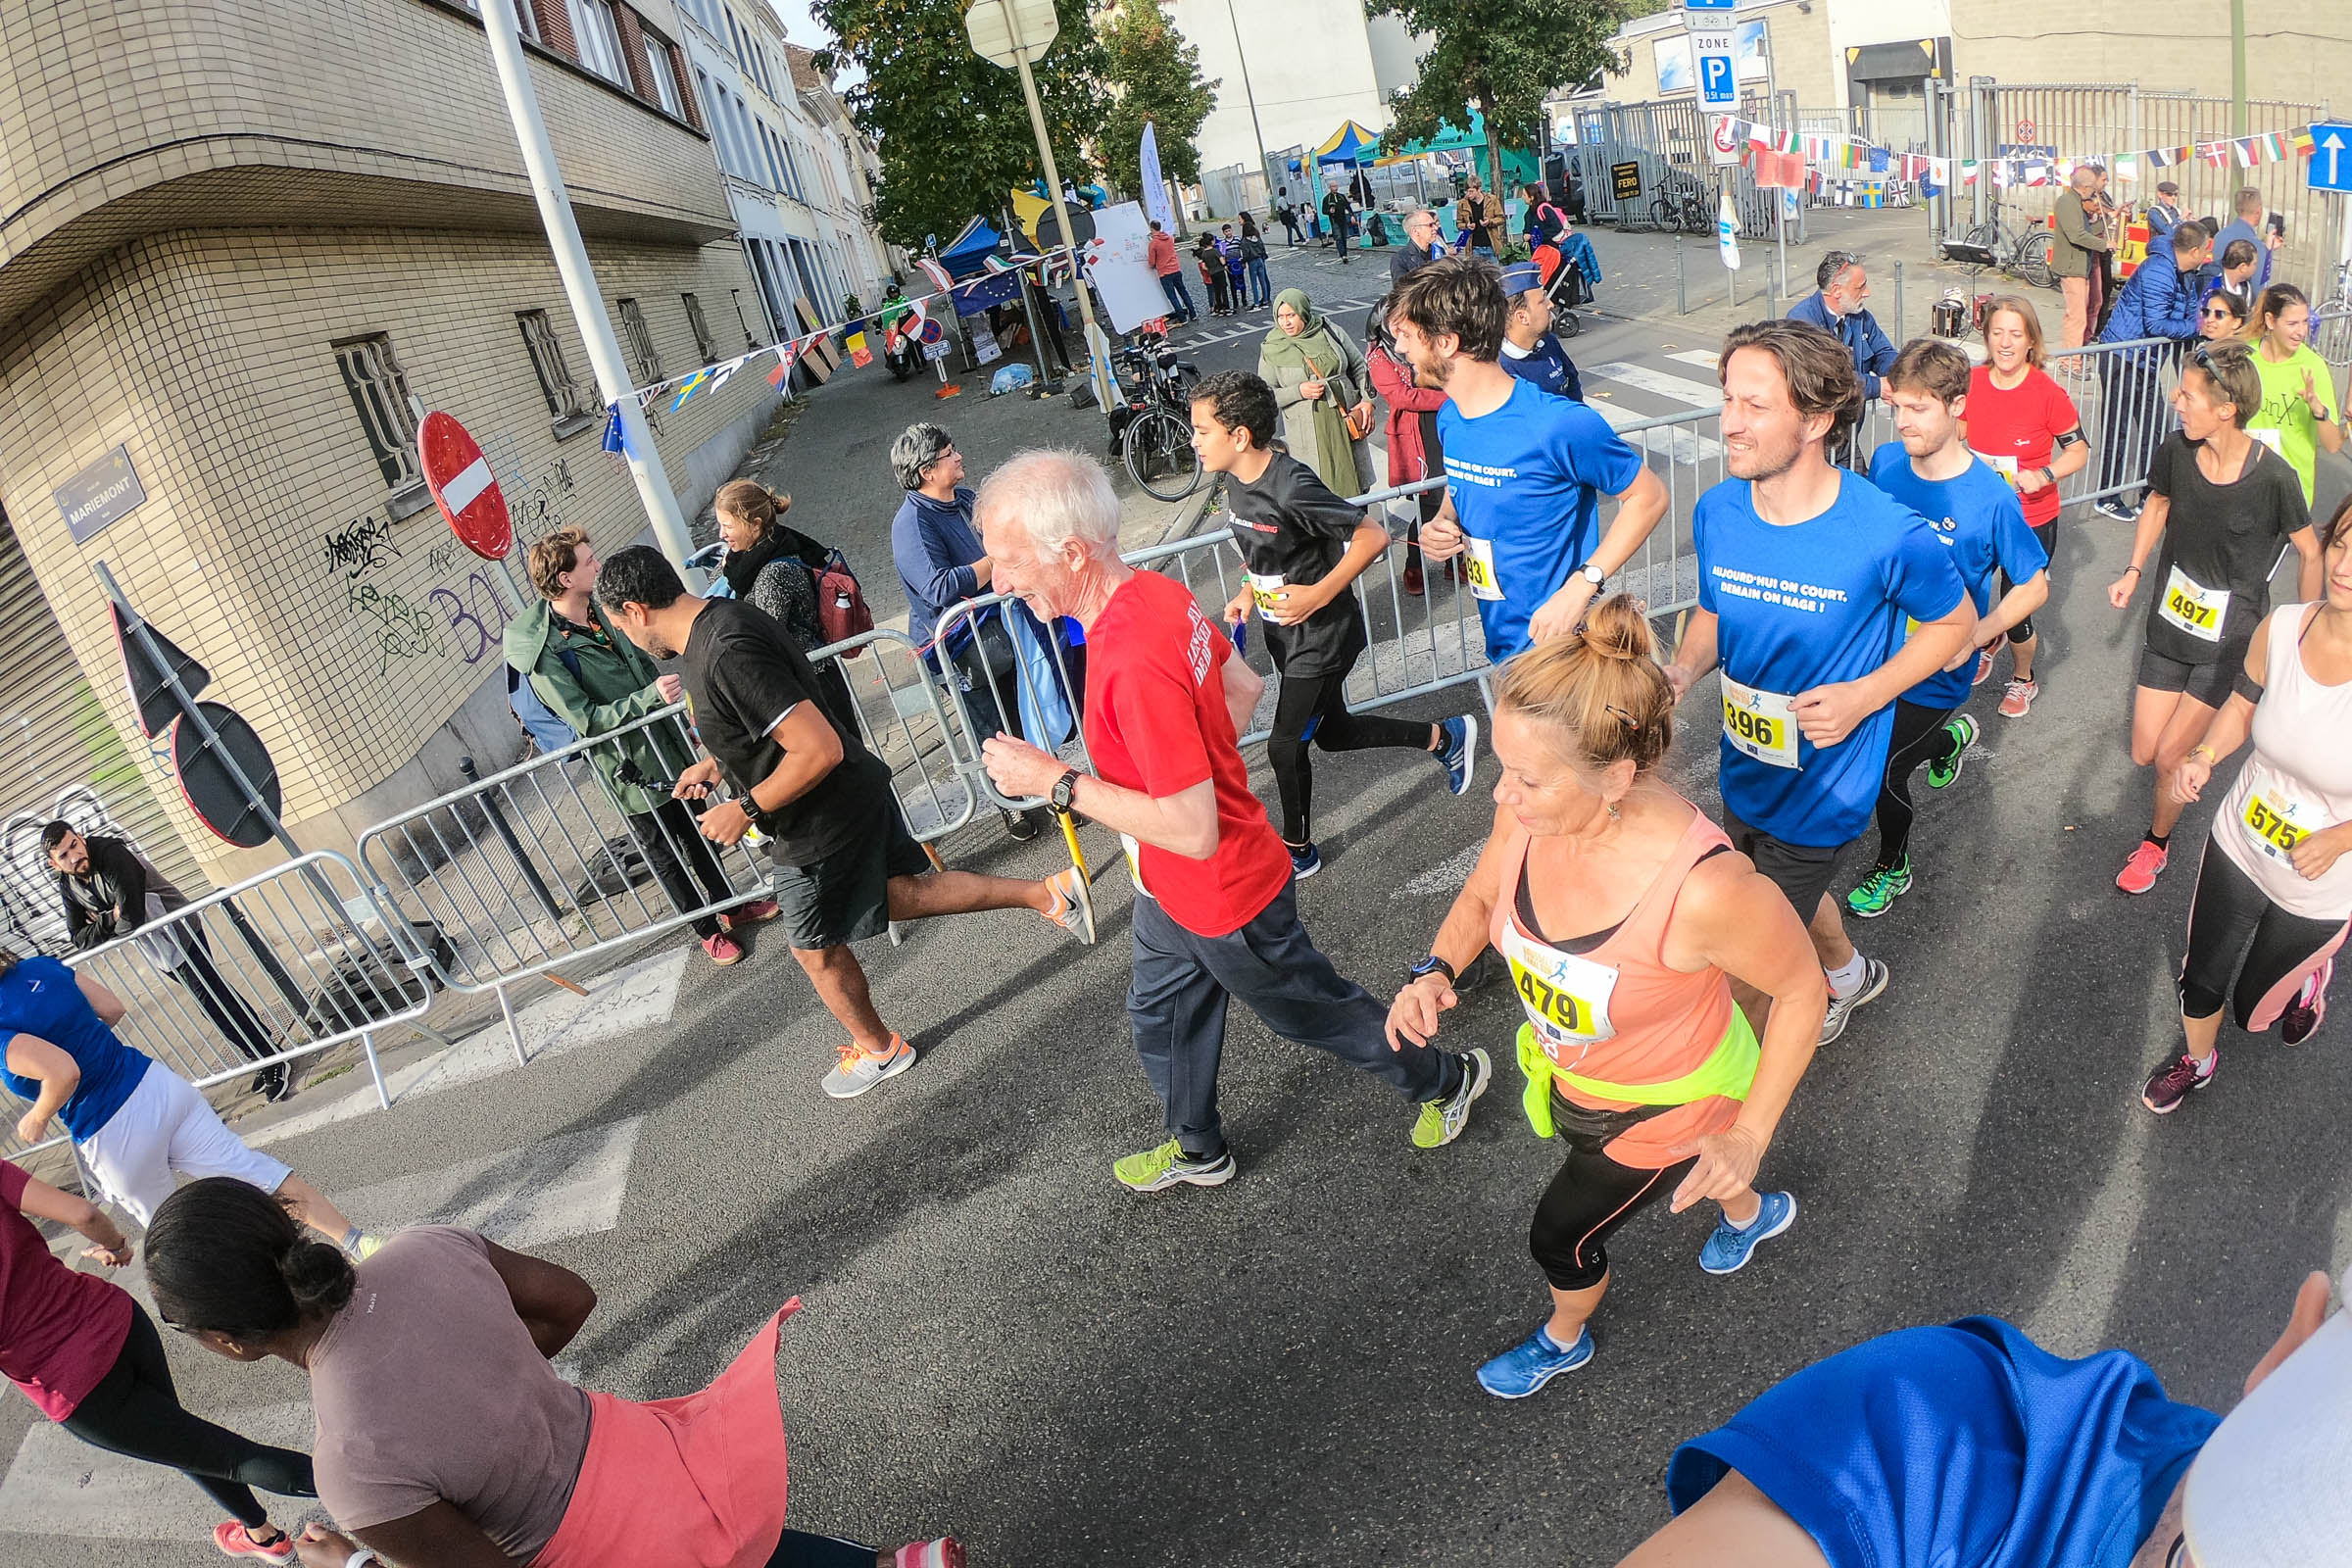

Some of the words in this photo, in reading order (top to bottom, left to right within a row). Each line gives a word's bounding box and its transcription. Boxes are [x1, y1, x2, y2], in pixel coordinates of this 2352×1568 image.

[1698, 38, 1729, 48] ZONE
[1707, 59, 1726, 89] P
[1618, 177, 1638, 189] FERO
[69, 476, 130, 525] MARIEMONT
[1712, 565, 1779, 590] AUJOURD'HUI
[1779, 579, 1799, 594] ON
[1720, 581, 1761, 601] DEMAIN
[1762, 591, 1782, 604] ON
[1782, 595, 1816, 612] NAGE
[1819, 602, 1826, 613] !
[2172, 594, 2210, 623] 497
[1727, 702, 1772, 746] 396
[2251, 802, 2298, 851] 575
[1520, 970, 1578, 1030] 479
